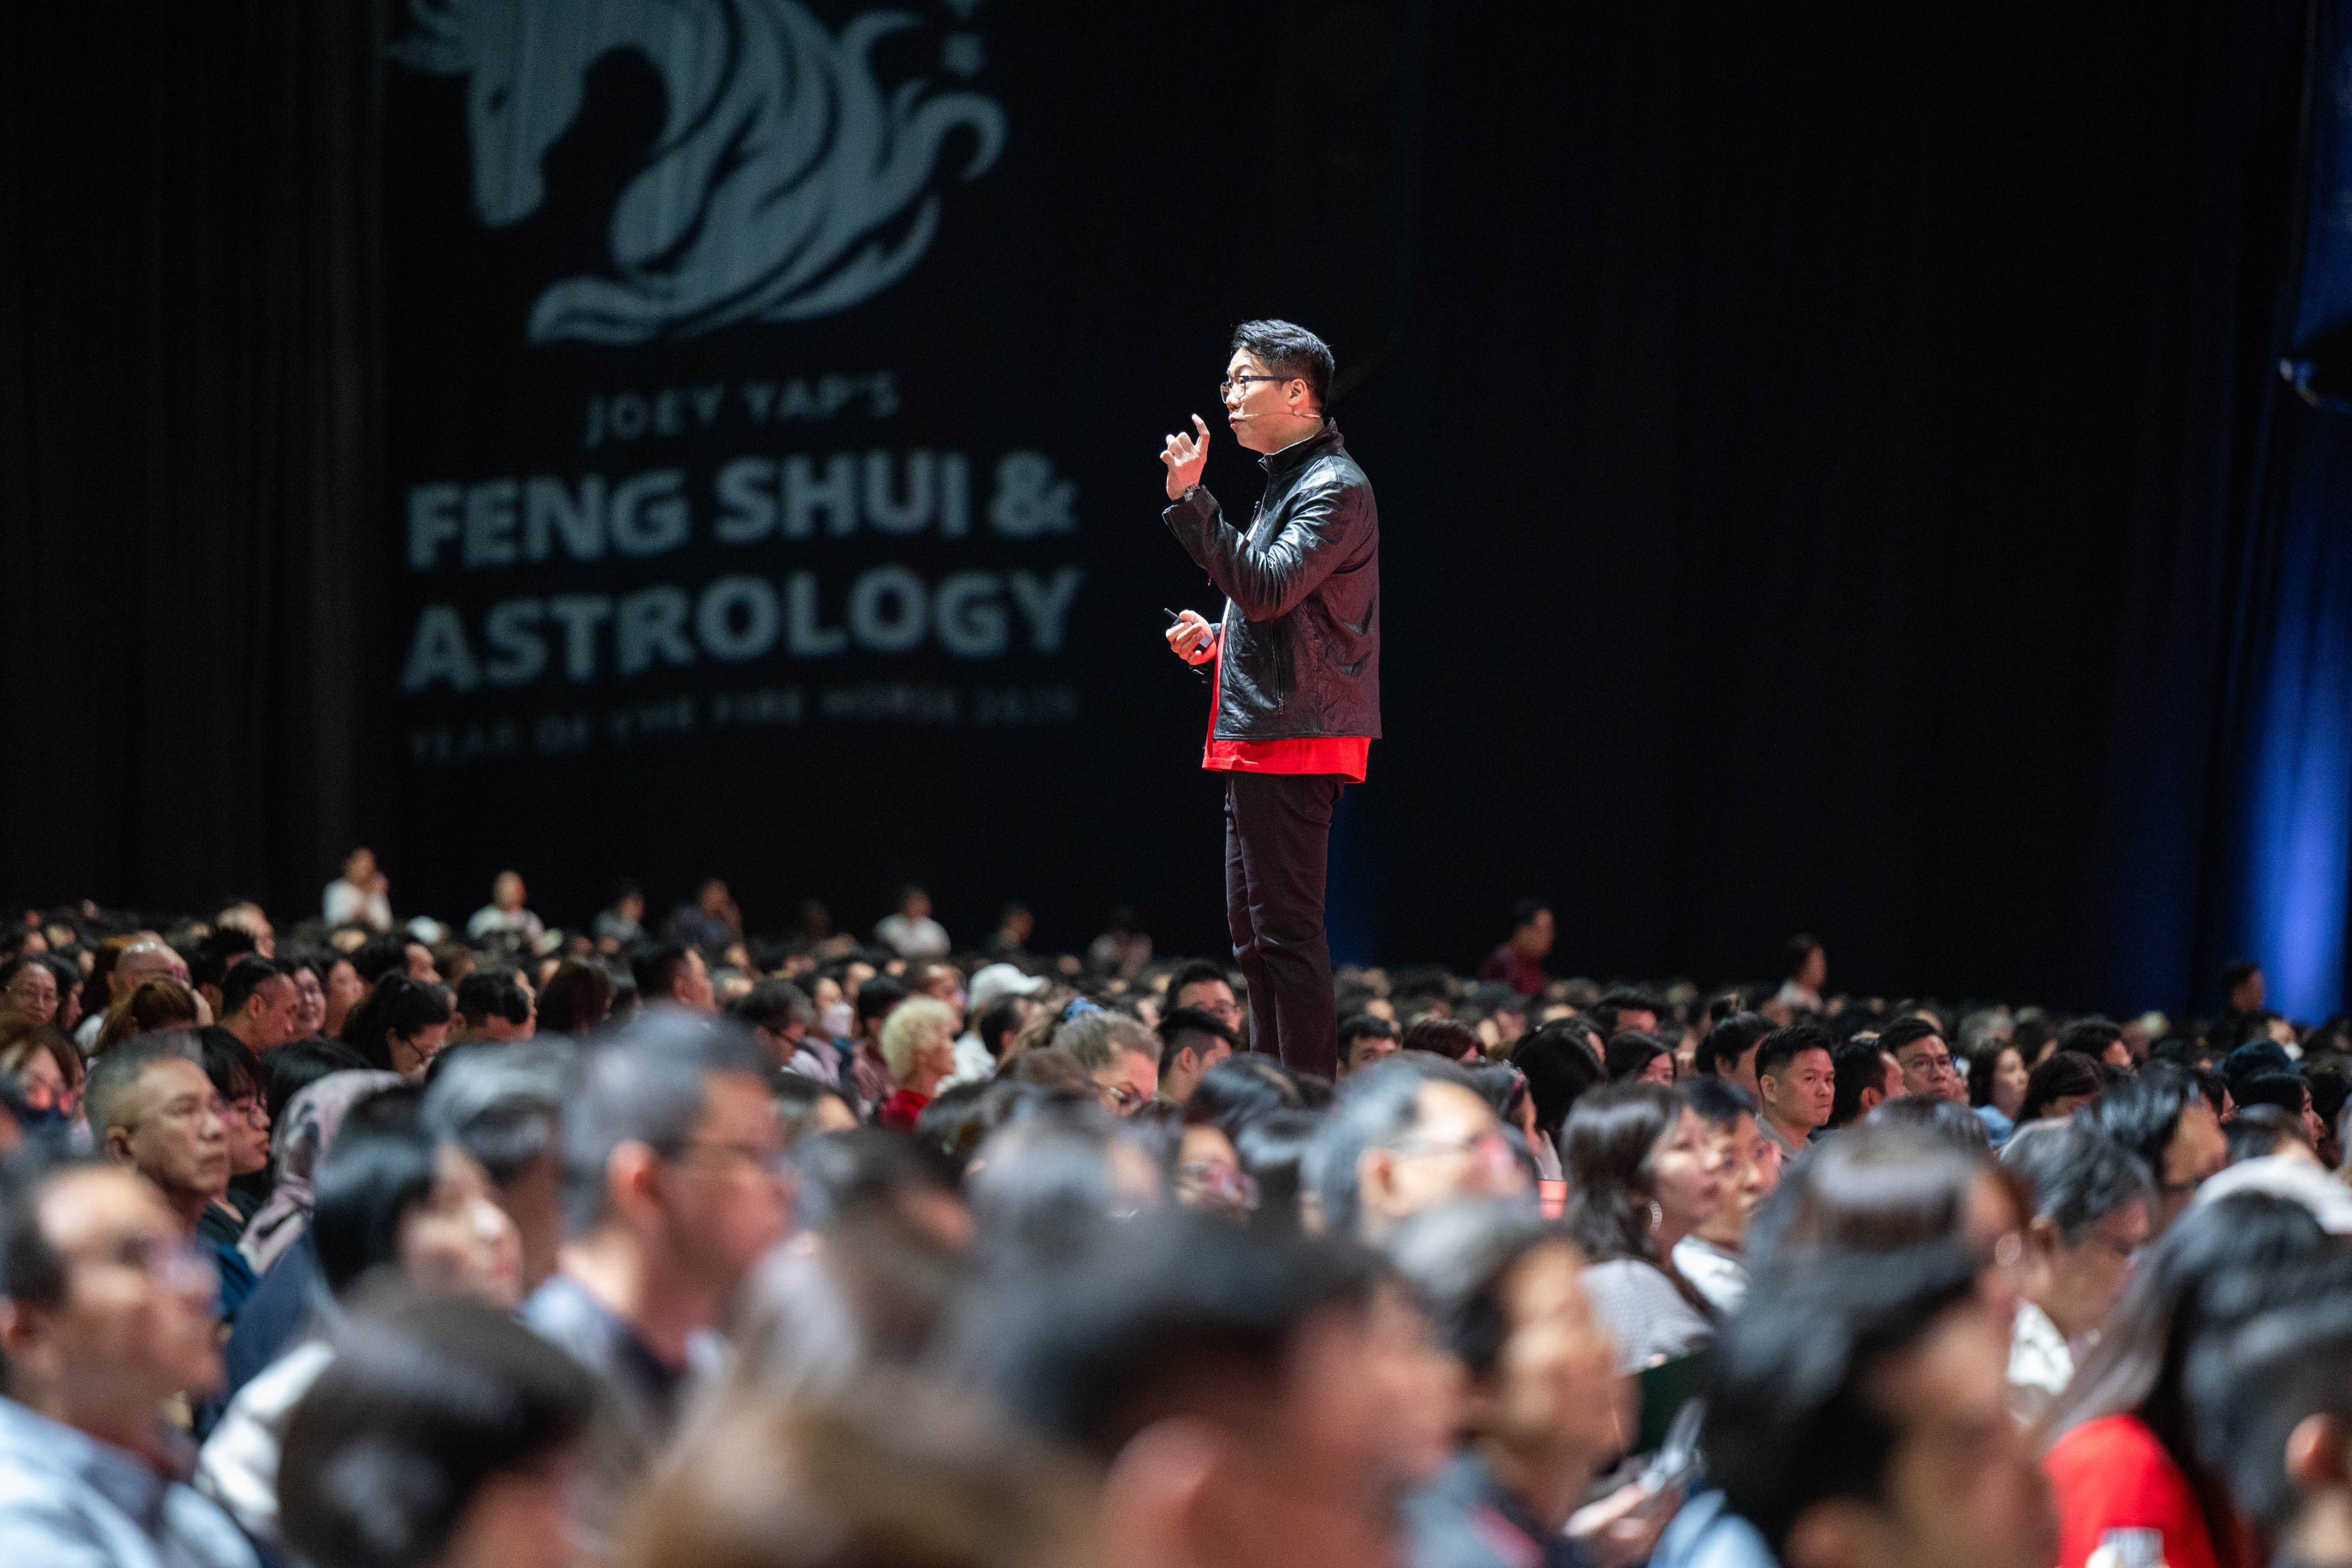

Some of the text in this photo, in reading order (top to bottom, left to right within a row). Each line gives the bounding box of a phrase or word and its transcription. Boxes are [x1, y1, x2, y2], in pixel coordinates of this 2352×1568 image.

[583, 383, 725, 449] JOEY
[408, 450, 1077, 569] FENG SHUI &
[402, 564, 1082, 690] ASTROLOGY
